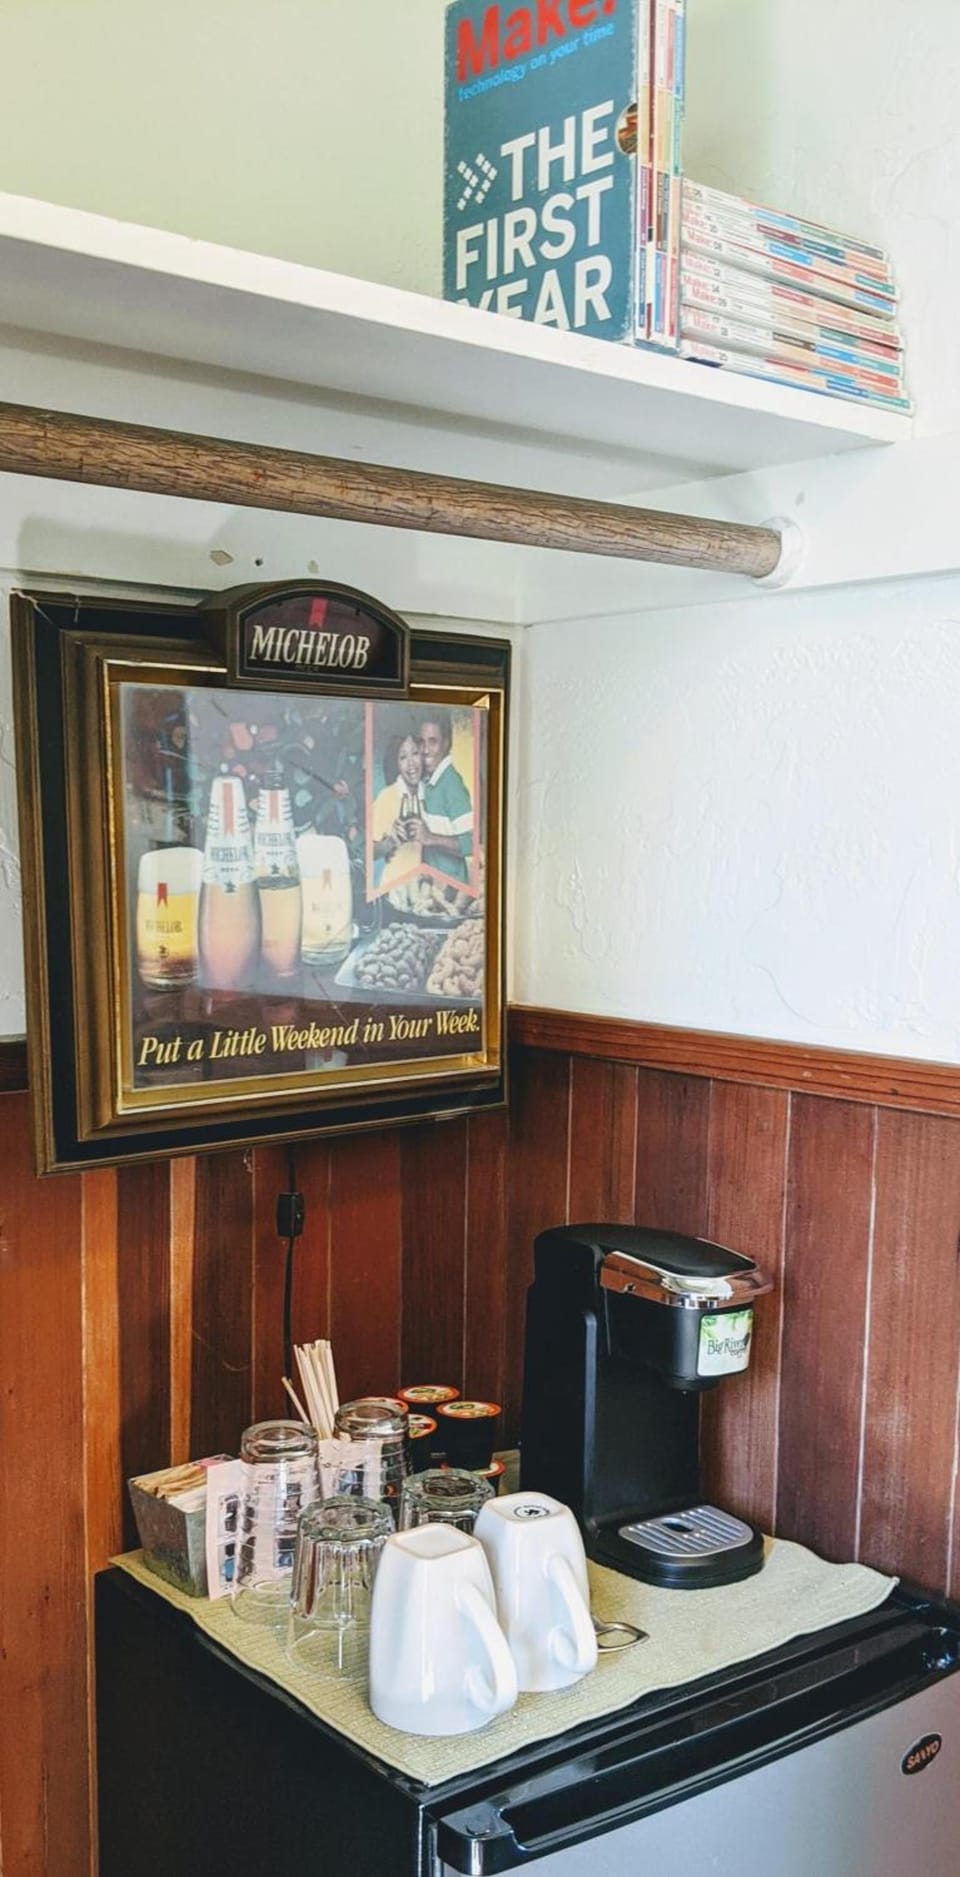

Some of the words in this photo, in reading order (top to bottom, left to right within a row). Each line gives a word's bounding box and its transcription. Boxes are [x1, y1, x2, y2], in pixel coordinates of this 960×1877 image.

[458, 63, 526, 101] technology
[530, 53, 547, 70] on
[550, 38, 579, 65] your
[583, 22, 614, 46] time
[501, 99, 614, 201] THE
[456, 175, 613, 290] FIRST
[250, 625, 370, 669] MICHELOB
[137, 1036, 181, 1066] Put
[187, 1039, 204, 1061] a
[208, 1027, 267, 1060] Little
[271, 1018, 360, 1053] Weekend
[363, 1017, 384, 1043] in
[389, 1014, 432, 1041] Your
[436, 1007, 480, 1036] Week.
[906, 1740, 940, 1769] SANYO
